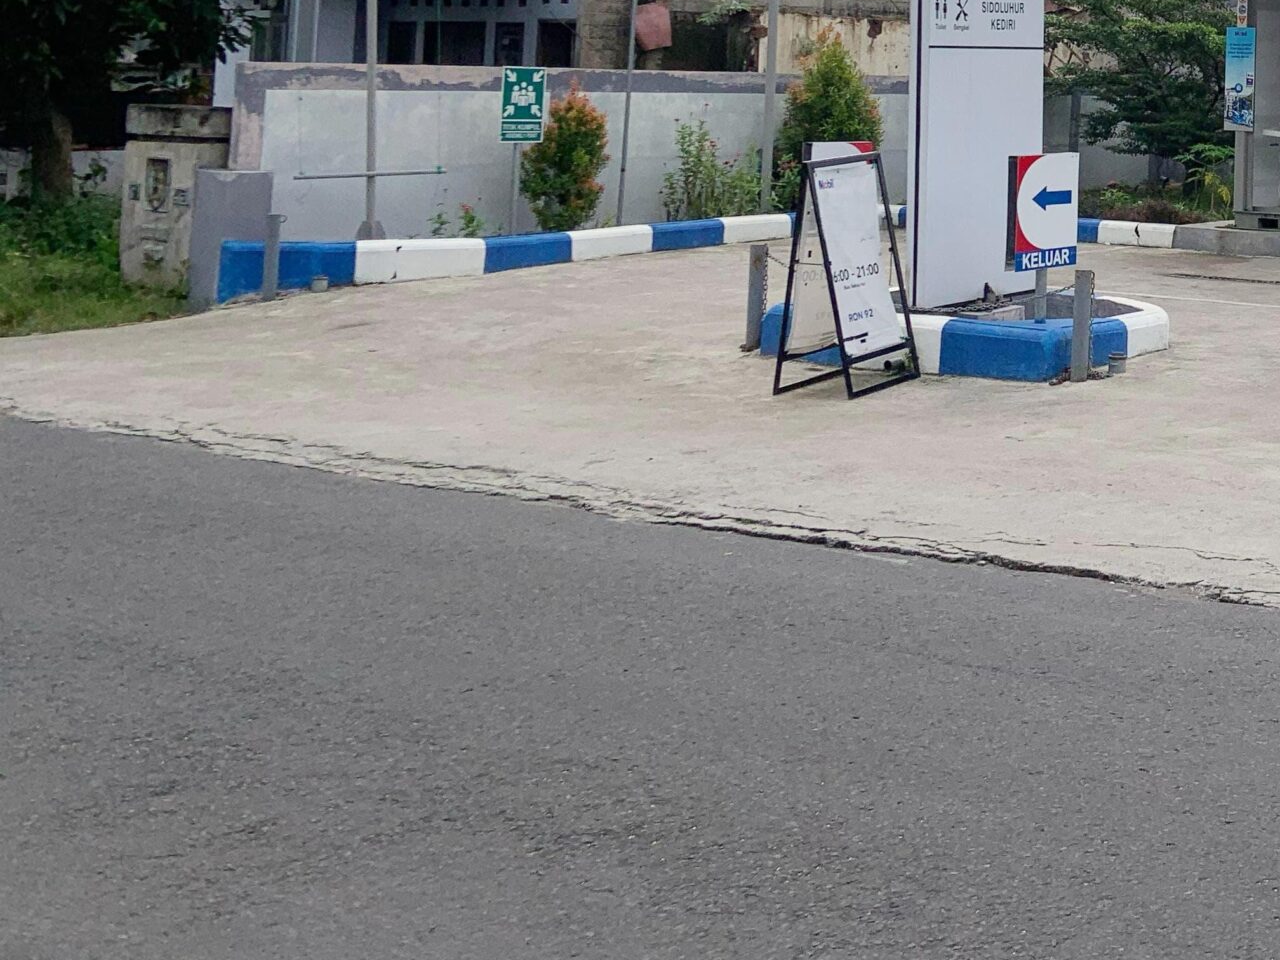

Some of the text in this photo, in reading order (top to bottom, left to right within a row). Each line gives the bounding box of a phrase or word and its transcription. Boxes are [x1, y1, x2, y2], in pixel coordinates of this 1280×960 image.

[981, 1, 1025, 14] SIDOLUHUR
[990, 19, 1016, 30] KEDIRI
[1022, 248, 1070, 270] KELUAR
[856, 262, 880, 278] 21:00
[848, 308, 874, 322] RON 92
